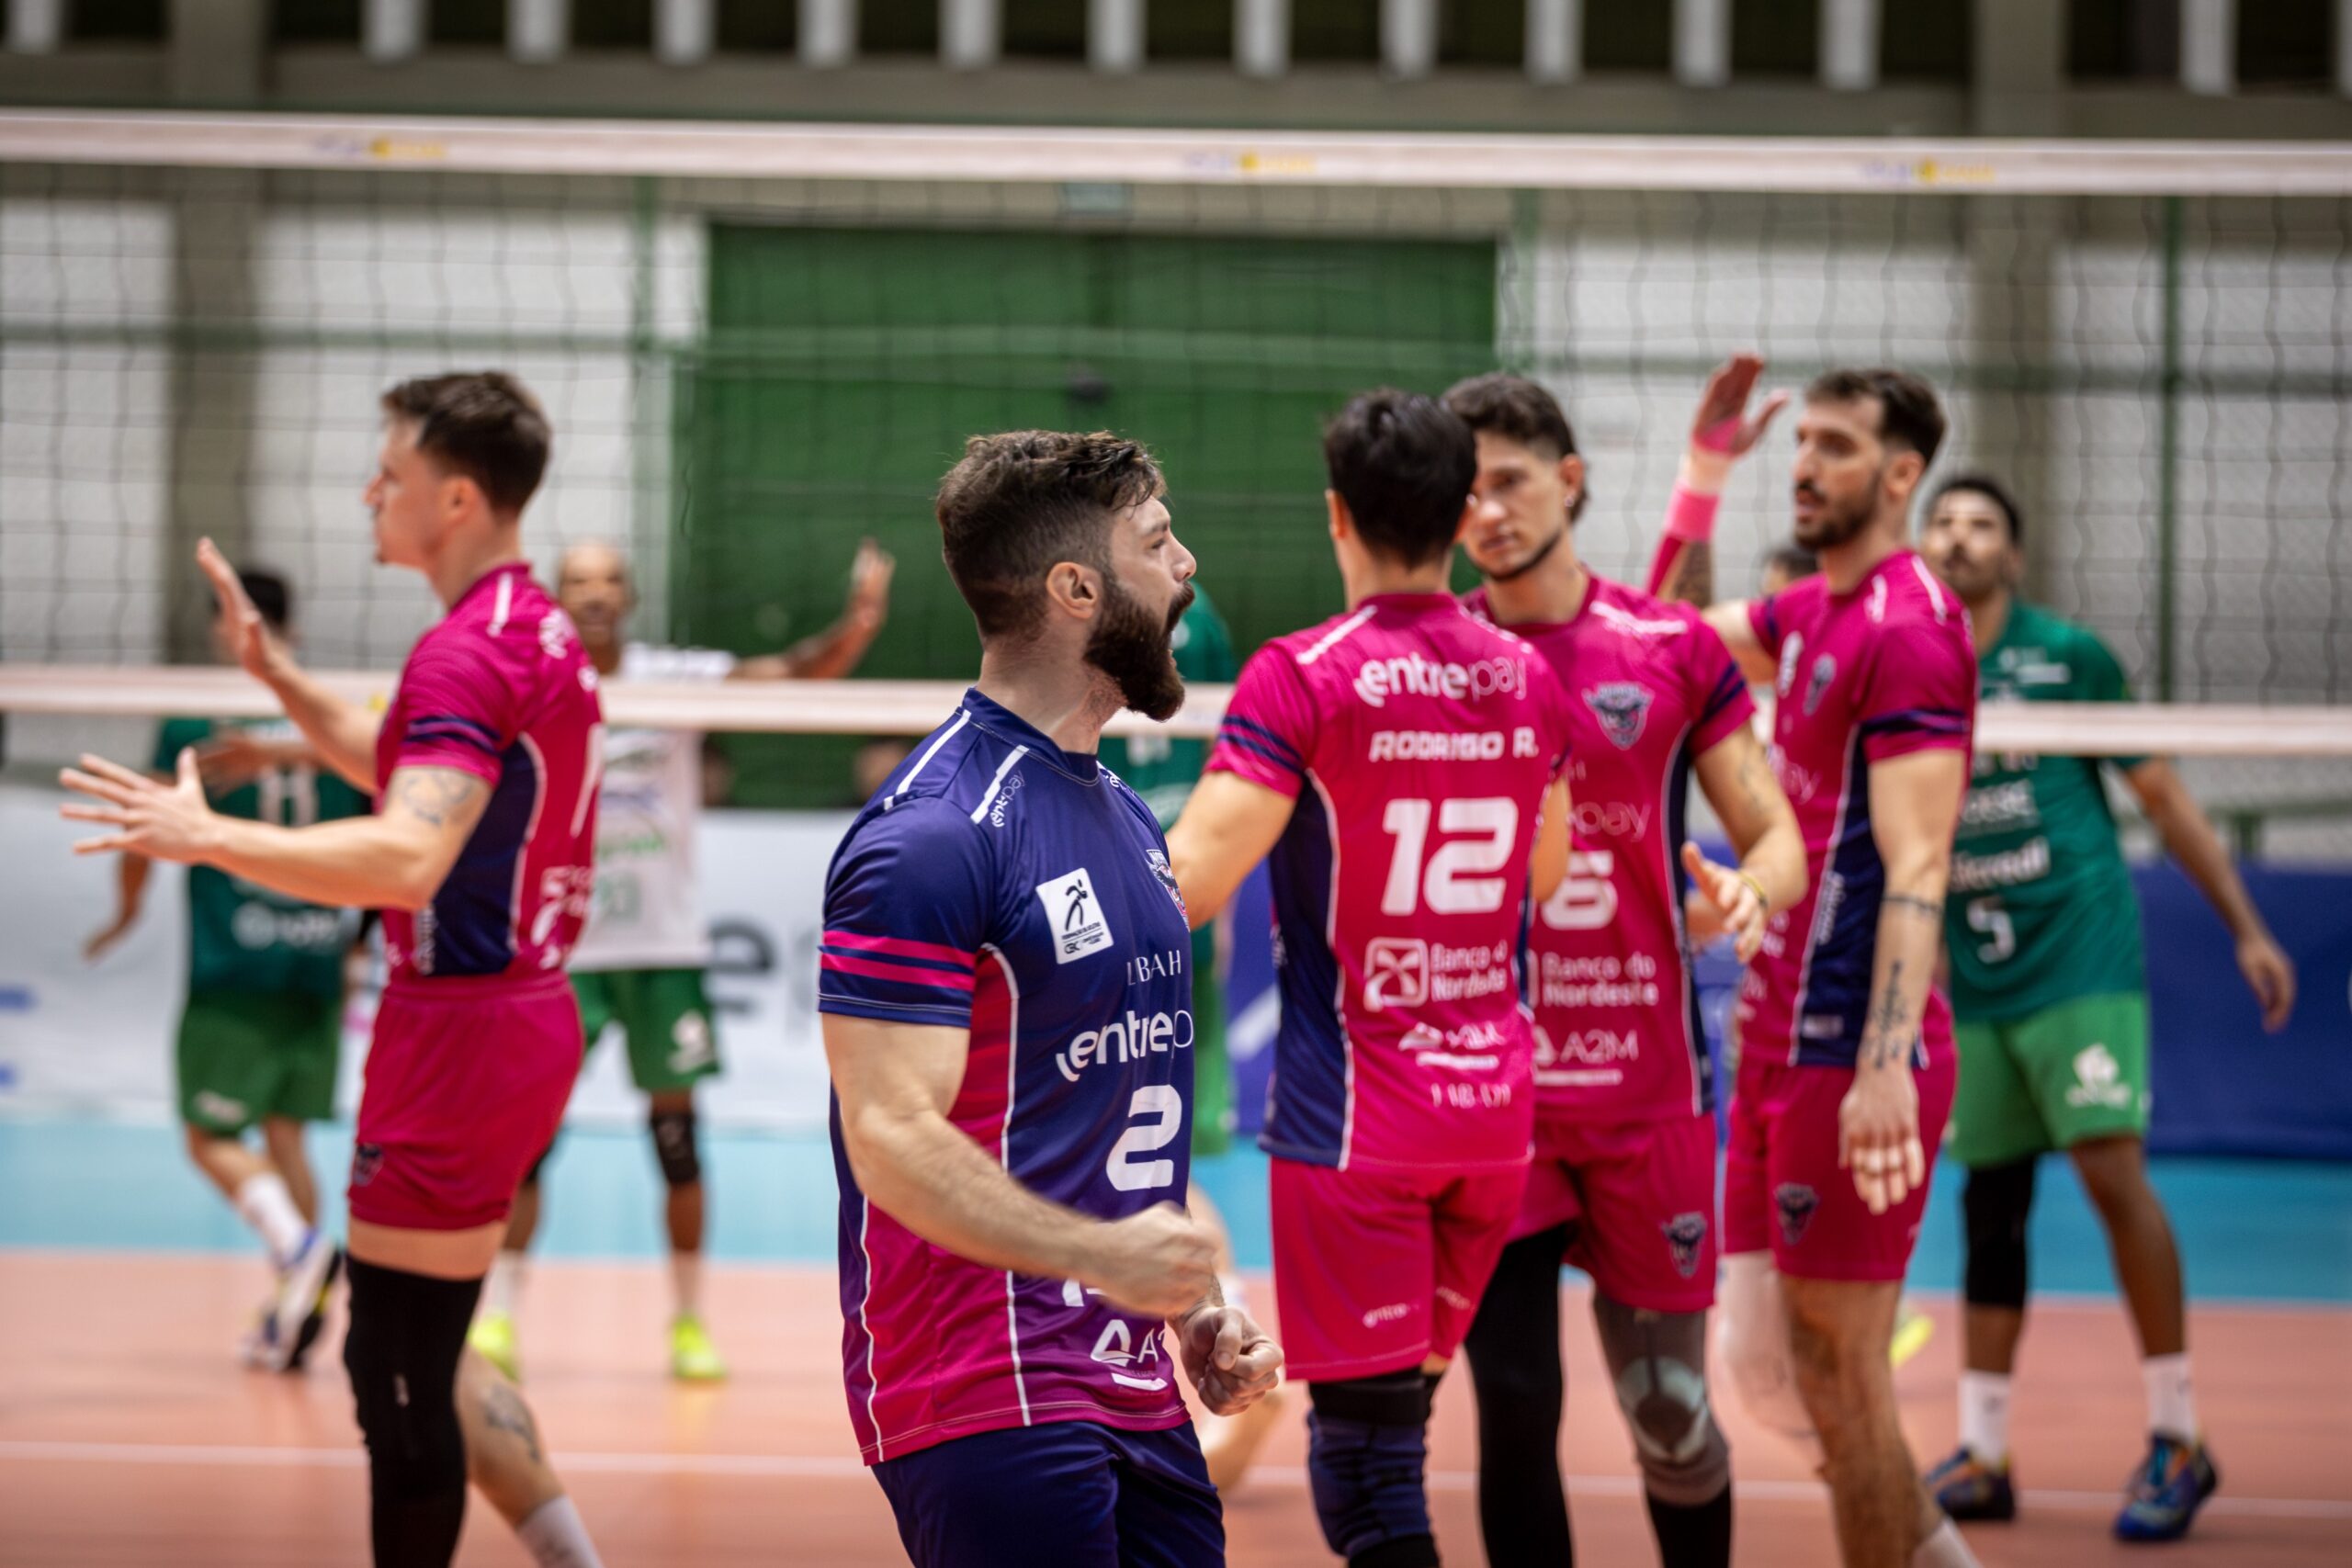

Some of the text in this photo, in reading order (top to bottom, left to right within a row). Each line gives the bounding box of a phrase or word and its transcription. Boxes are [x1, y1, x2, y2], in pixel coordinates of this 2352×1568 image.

[1352, 653, 1527, 708] entrepay
[1368, 727, 1540, 762] RODRIGO R.
[1381, 796, 1519, 916] 12
[1430, 942, 1490, 973] Banco
[1543, 952, 1621, 981] Banco
[1056, 1010, 1193, 1082] entrep
[1560, 1029, 1639, 1063] A2M
[1106, 1085, 1182, 1191] 2
